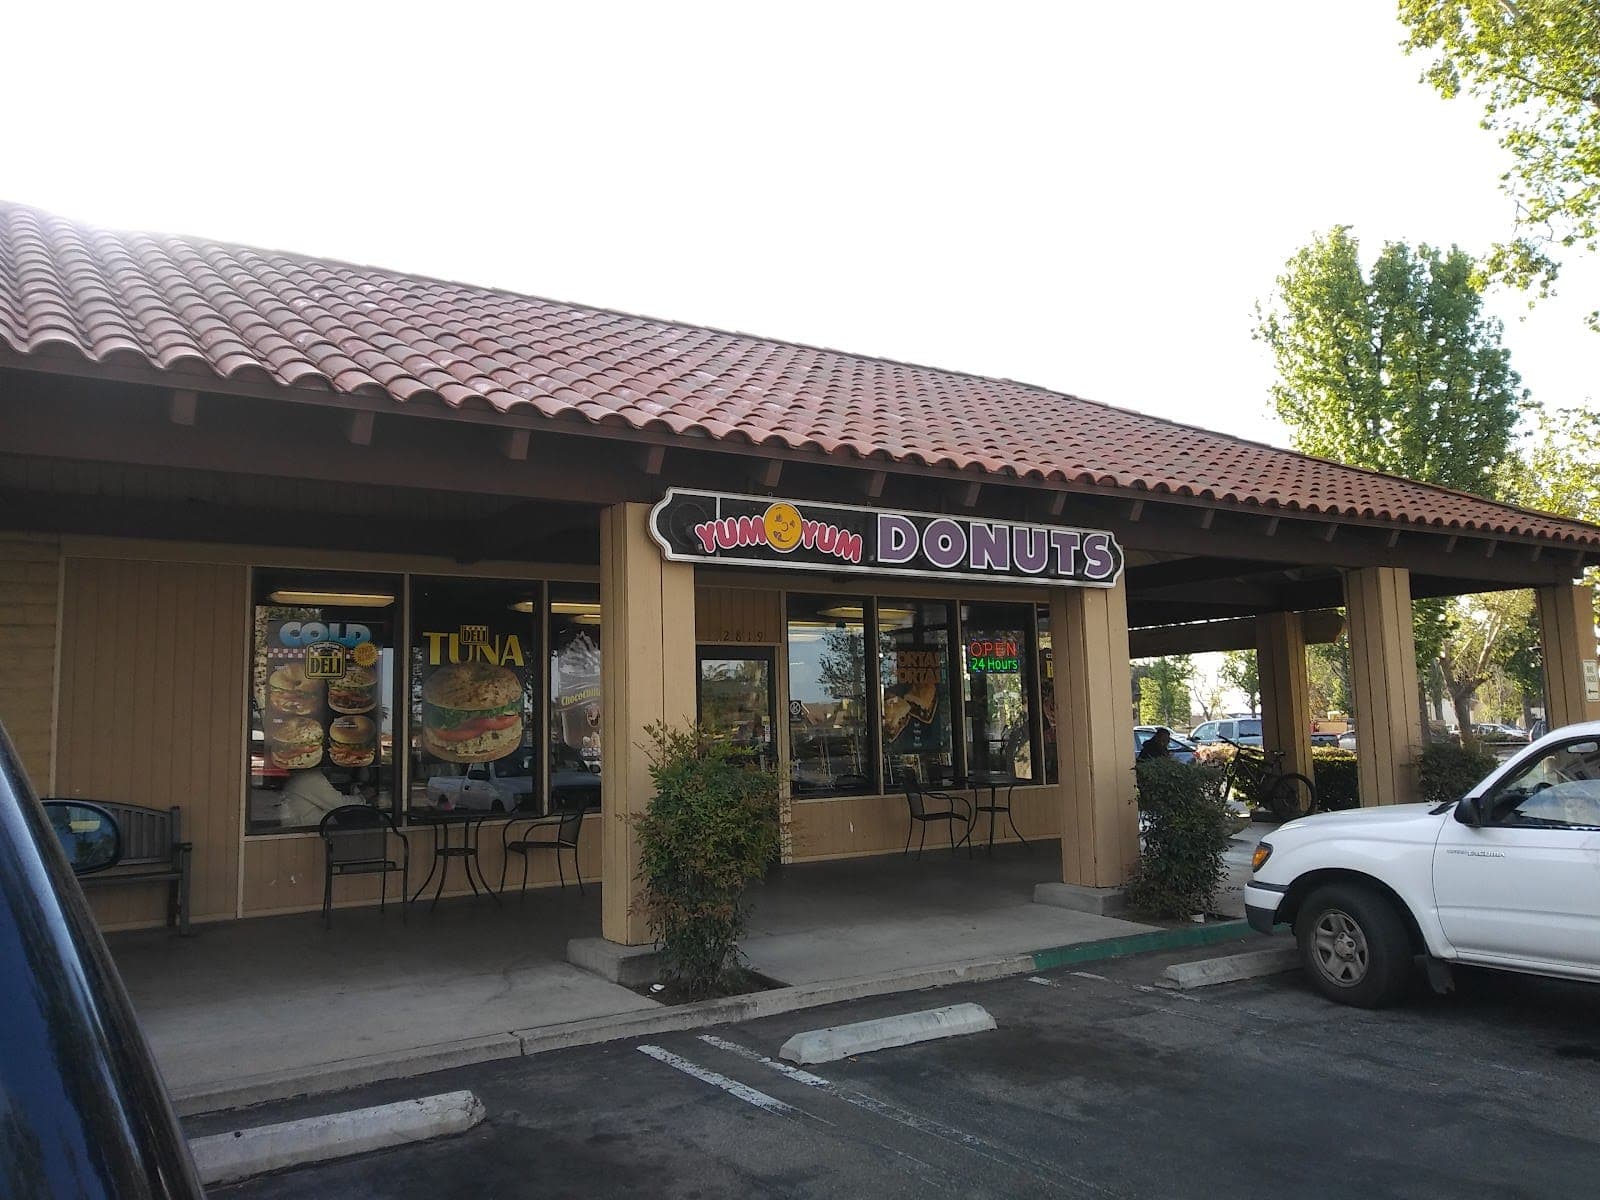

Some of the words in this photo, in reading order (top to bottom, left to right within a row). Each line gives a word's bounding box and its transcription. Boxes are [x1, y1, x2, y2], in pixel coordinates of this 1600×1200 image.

[694, 515, 767, 553] YUM
[800, 518, 863, 563] YUM
[877, 513, 1115, 579] DONUTS
[279, 620, 372, 648] COLD
[463, 629, 487, 643] DELI
[422, 631, 525, 667] TUNA
[969, 641, 1018, 657] OPEN
[309, 657, 342, 674] DELI
[970, 657, 986, 670] 24
[987, 657, 1018, 671] Hours
